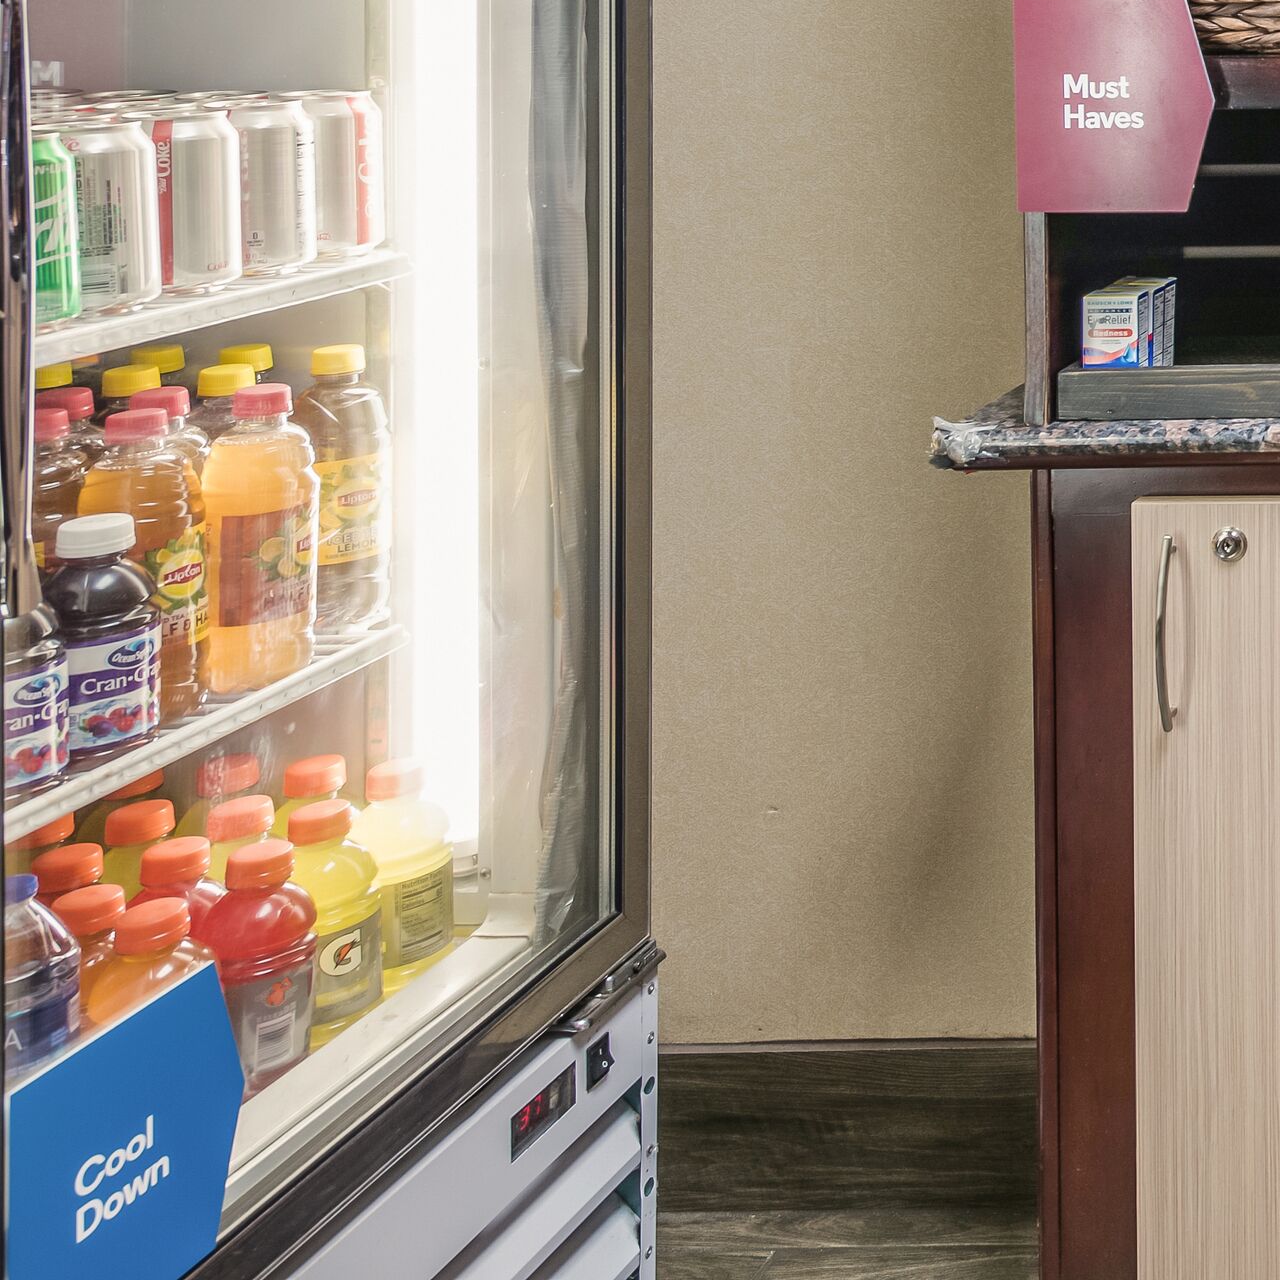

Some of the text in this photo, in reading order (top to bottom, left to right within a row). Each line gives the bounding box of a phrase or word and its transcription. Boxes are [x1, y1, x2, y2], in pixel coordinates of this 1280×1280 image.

[1063, 73, 1131, 99] Must
[1063, 103, 1145, 131] Haves
[164, 567, 202, 585] Lipton
[74, 1114, 156, 1198] Cool
[75, 1154, 172, 1244] Down
